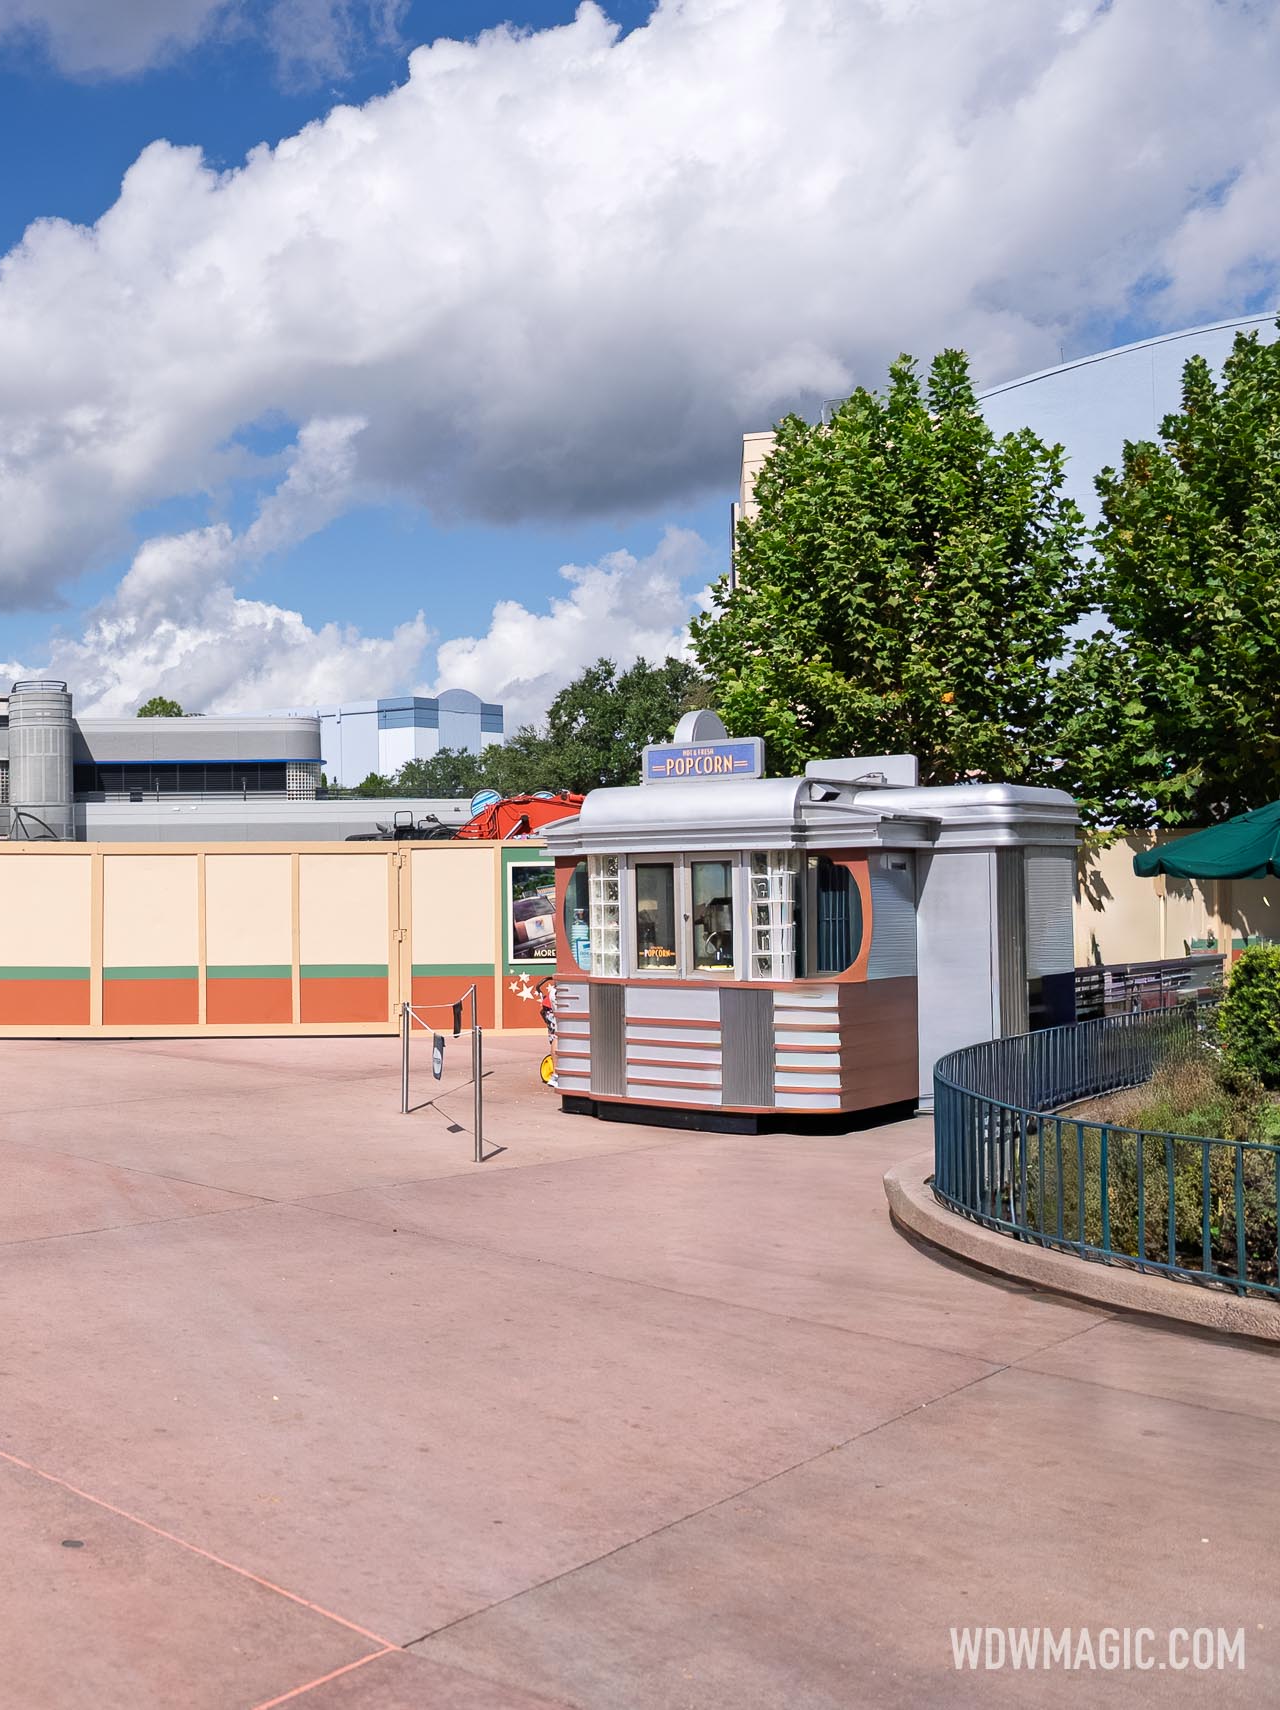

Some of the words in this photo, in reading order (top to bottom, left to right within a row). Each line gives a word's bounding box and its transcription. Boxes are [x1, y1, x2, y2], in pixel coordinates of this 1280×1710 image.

[666, 754, 734, 776] POPCORN
[534, 949, 556, 957] MORE
[644, 949, 671, 958] POPCORN
